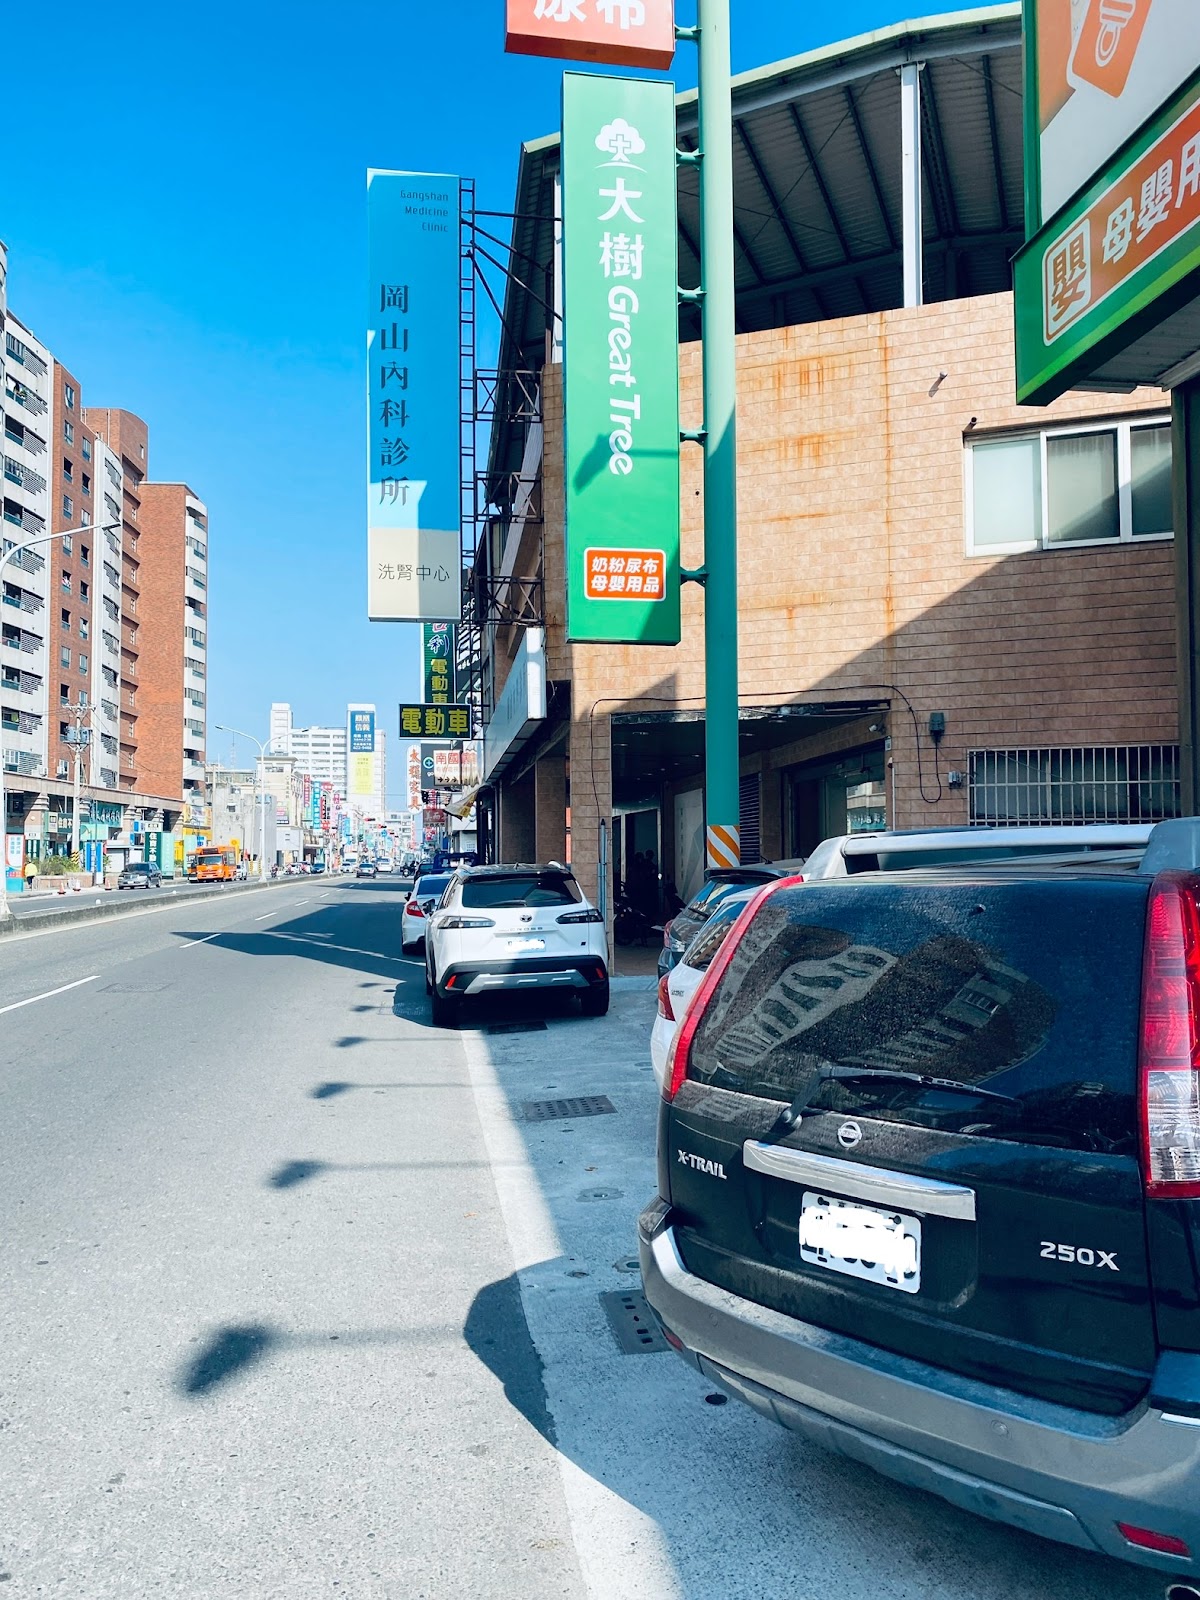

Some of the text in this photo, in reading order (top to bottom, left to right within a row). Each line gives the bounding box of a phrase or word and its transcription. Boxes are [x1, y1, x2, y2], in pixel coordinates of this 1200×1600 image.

[400, 190, 449, 202] Gangshan
[405, 206, 449, 217] Medicine
[421, 222, 449, 232] Clinic
[597, 177, 646, 281] 大樹
[1052, 238, 1087, 323] 嬰
[607, 285, 642, 476] Great Tree
[379, 283, 411, 507] 岡山內科診所
[377, 562, 450, 583] 洗腎中心
[591, 556, 660, 574] 奶粉尿布
[591, 574, 660, 593] 母嬰用品
[401, 707, 469, 735] 電動車
[677, 1149, 728, 1180] X-TRAIL
[1039, 1240, 1121, 1272] 250X
